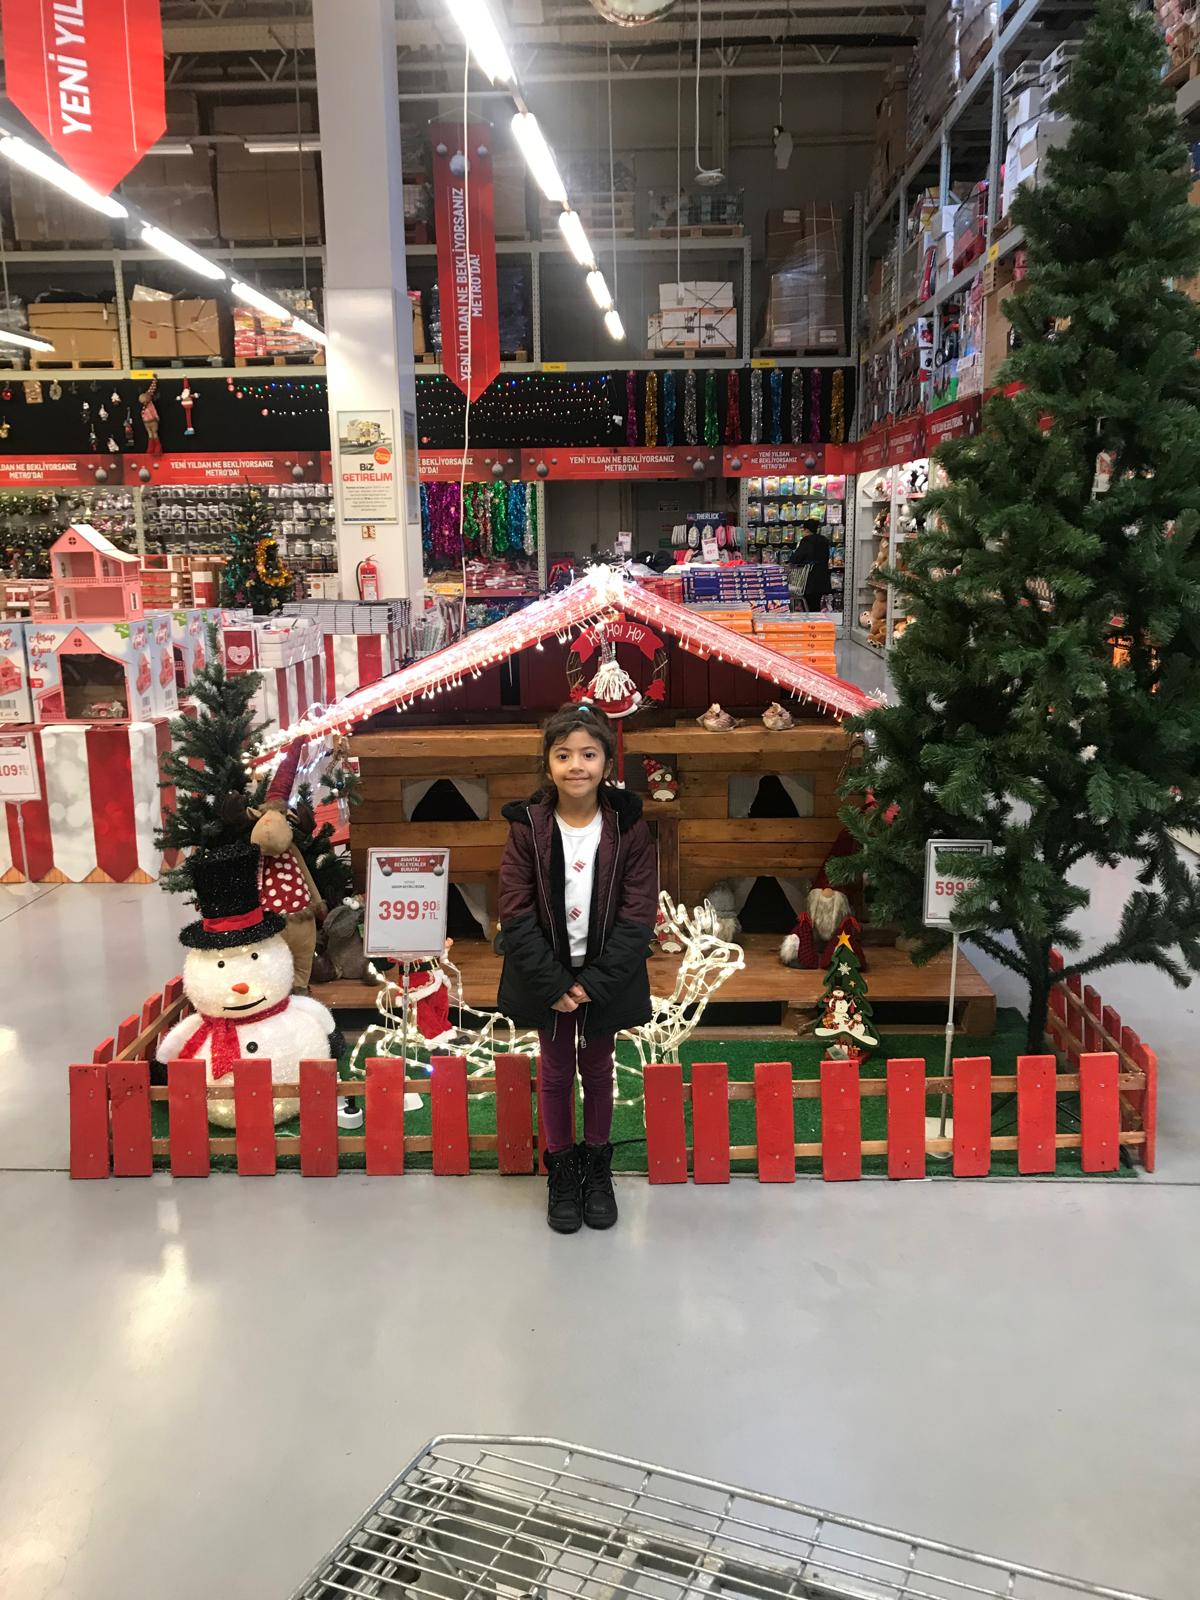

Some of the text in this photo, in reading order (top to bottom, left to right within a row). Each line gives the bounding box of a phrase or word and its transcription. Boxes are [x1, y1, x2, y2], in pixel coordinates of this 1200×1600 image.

[48, 53, 92, 135] YENİ
[452, 187, 468, 284] BEKLİYORSANIZ
[470, 253, 483, 317] METRO'DA!
[457, 286, 469, 304] NE
[170, 458, 274, 469] YENİ YILDAN NE BEKLİYORSANIZ
[569, 454, 675, 463] YENİ YILDAN NE BEKLİYORSANIZ
[16, 463, 26, 471] NE
[26, 461, 77, 471] BEKLİYORSANIZ
[604, 464, 639, 472] METRO'DA!
[9, 471, 44, 479] METRO'DA!
[205, 469, 240, 477] METRO'DA!
[585, 623, 645, 646] HO HO! HO!
